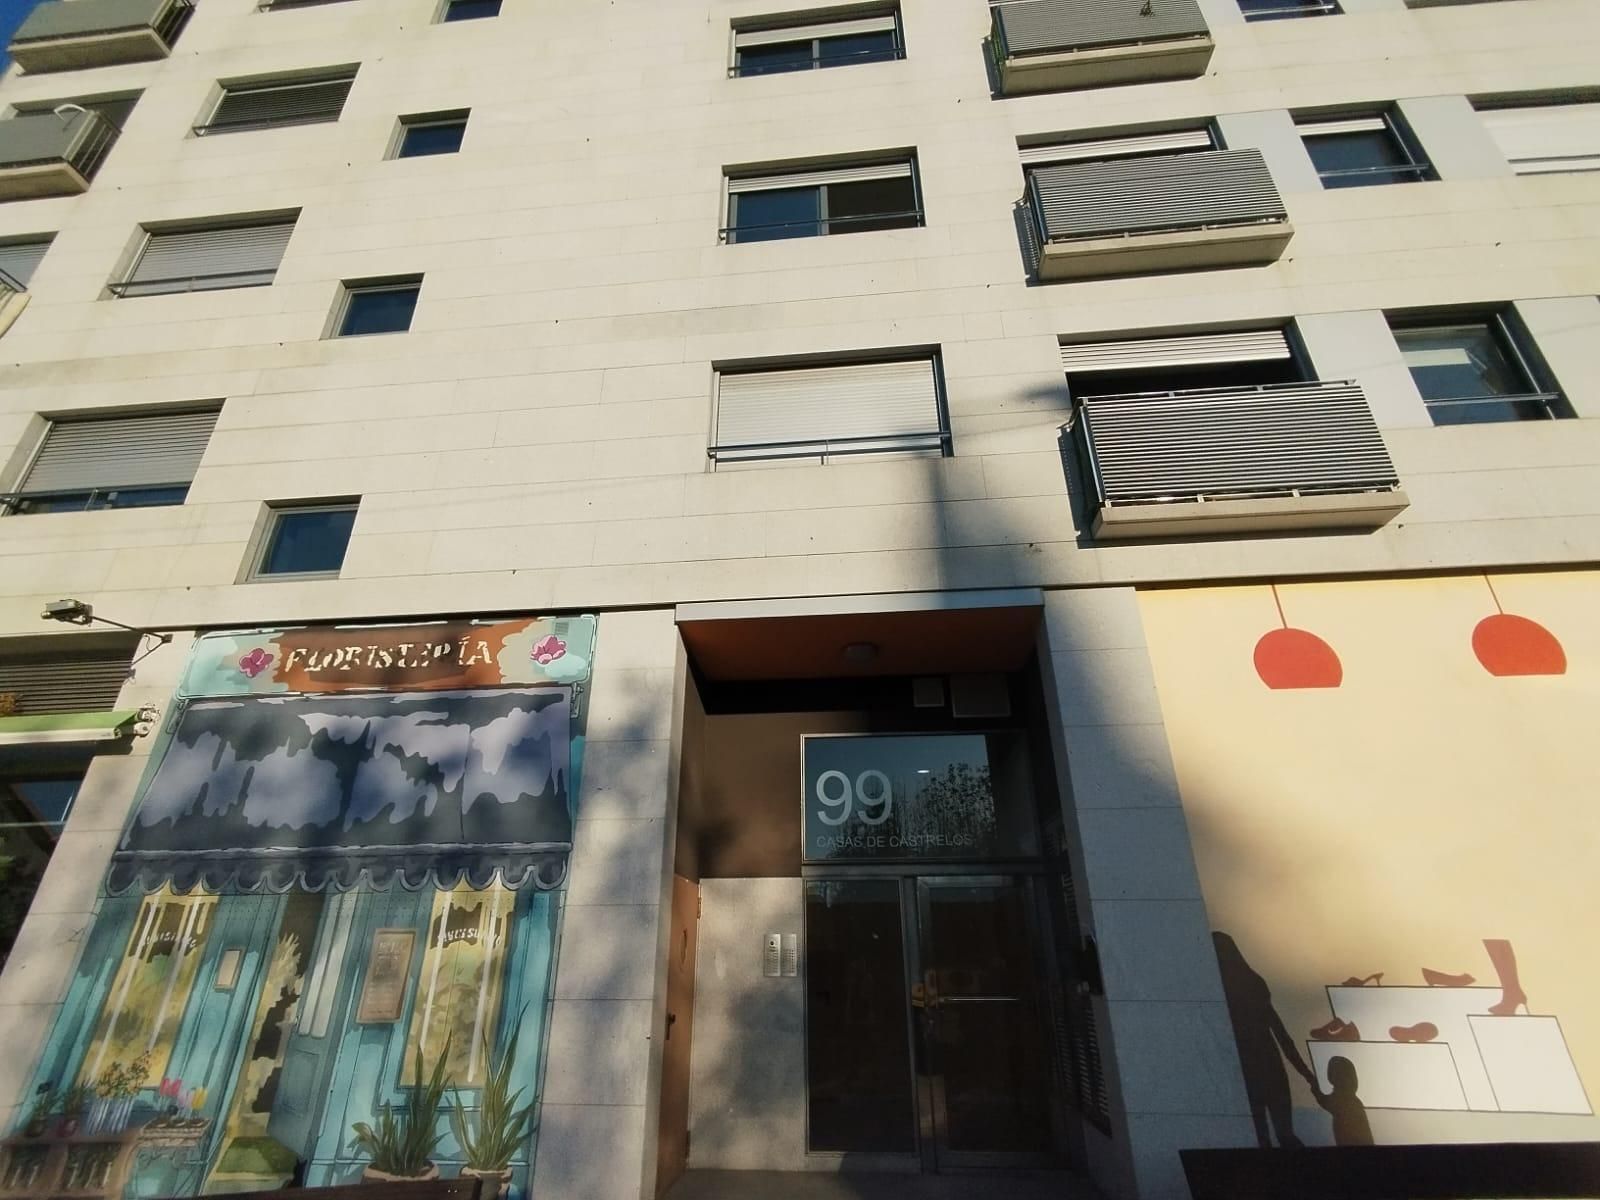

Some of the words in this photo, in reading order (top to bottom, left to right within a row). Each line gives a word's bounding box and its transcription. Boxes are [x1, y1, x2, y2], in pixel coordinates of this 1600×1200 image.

[816, 770, 892, 826] 99
[816, 836, 863, 848] CASAS
[867, 835, 885, 848] DE
[889, 834, 973, 848] CASTRELOS
